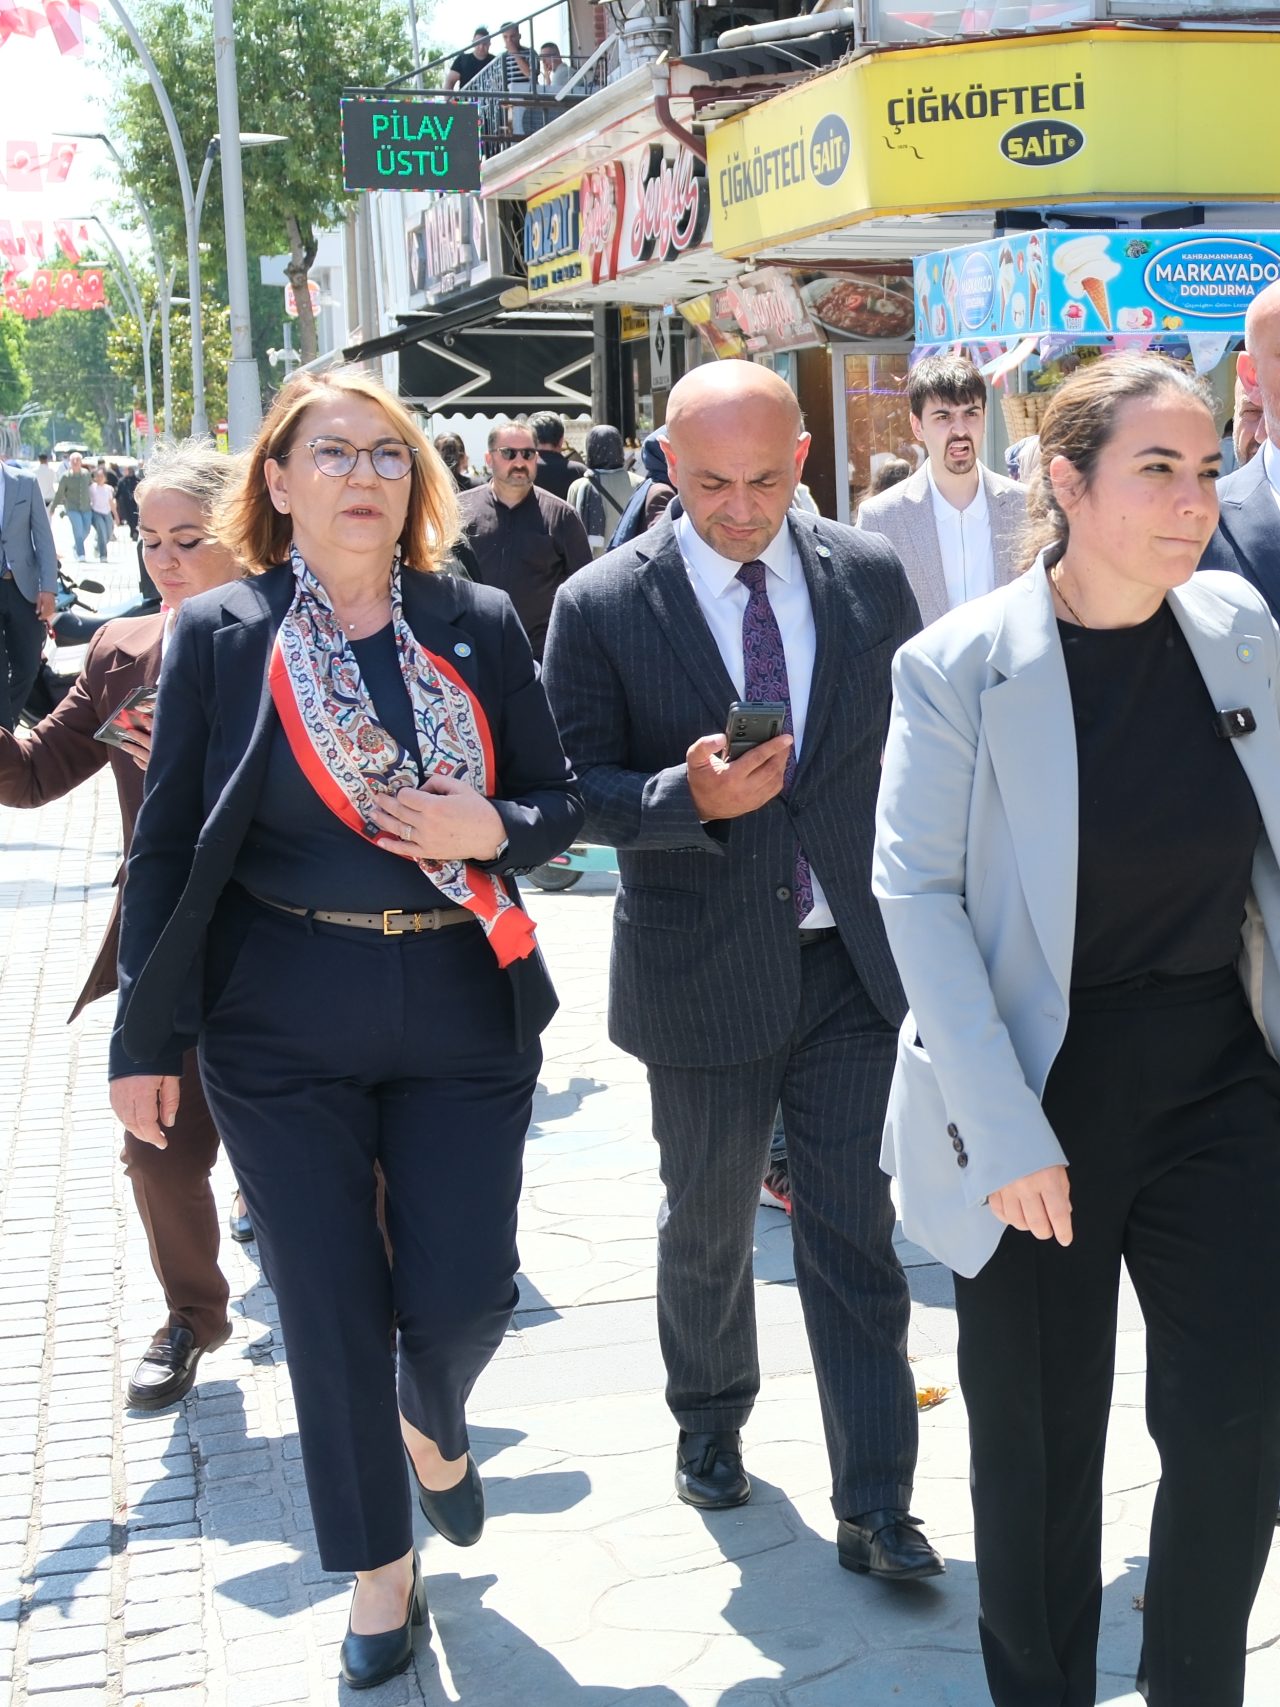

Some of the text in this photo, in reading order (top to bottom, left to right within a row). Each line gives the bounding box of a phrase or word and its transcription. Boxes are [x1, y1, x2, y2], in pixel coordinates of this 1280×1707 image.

[887, 72, 1085, 135] ÇİĞKÖFTECİ
[372, 115, 454, 141] PİLAV
[1007, 128, 1068, 159] SAİT
[376, 148, 449, 177] ÜSTÜ
[720, 125, 843, 221] ÇİĞKÖFTECİ SAİT
[1156, 263, 1279, 282] MARKAYADO
[1180, 284, 1255, 296] DONDURMA
